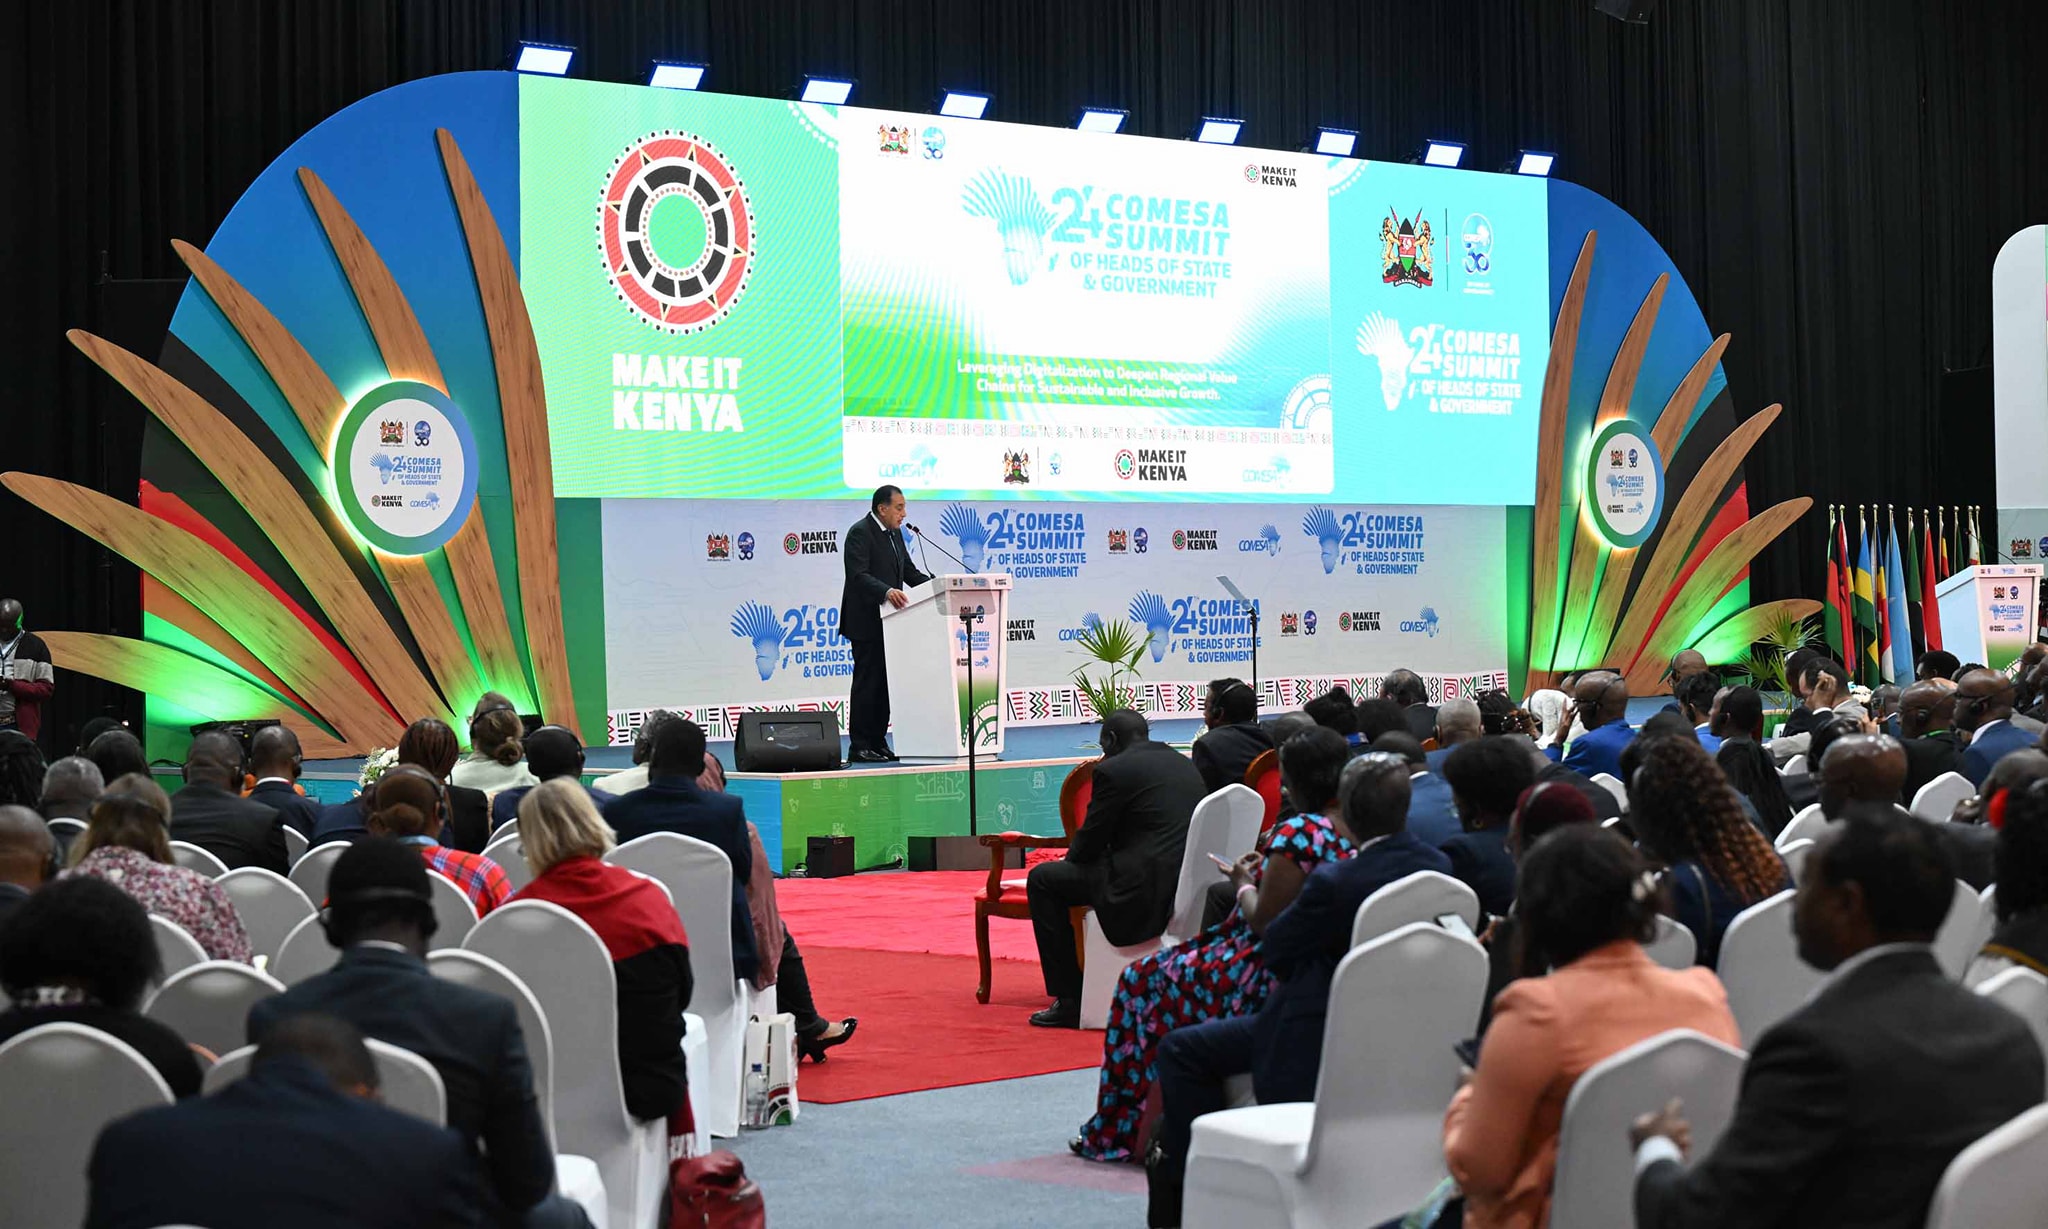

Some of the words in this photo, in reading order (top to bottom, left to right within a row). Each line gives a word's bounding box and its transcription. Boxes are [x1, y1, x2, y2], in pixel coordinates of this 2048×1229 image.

[1262, 165, 1288, 176] MAKE
[1289, 168, 1296, 176] IT
[1262, 176, 1297, 188] KENYA
[1051, 185, 1103, 243] 24
[1106, 193, 1229, 228] COMESA
[1106, 222, 1230, 256] SUMMIT
[1070, 252, 1092, 269] OF
[1097, 253, 1154, 274] HEADS
[1158, 258, 1179, 275] OF
[1183, 260, 1232, 278] STATE
[1083, 274, 1096, 290] &
[1101, 275, 1217, 299] GOVERNMENT
[1409, 324, 1442, 374] 24
[1442, 329, 1520, 356] COMESA
[613, 353, 709, 389] MAKE
[713, 356, 742, 390] IT
[957, 359, 1022, 378] Leveraging
[1024, 363, 1100, 380] Digitalization
[1102, 367, 1114, 379] to
[1117, 366, 1158, 382] Deepen
[1160, 368, 1206, 384] Regional
[1207, 370, 1238, 384] Value
[1442, 354, 1520, 380] SUMMIT
[977, 378, 1016, 392] Chains
[1018, 380, 1034, 393] for
[1037, 381, 1104, 396] Sustainable
[1106, 384, 1127, 396] and
[1129, 384, 1178, 398] Inclusive
[1180, 386, 1221, 400] Growth.
[1422, 380, 1436, 395] OF
[1438, 380, 1474, 396] HEADS
[1475, 382, 1489, 398] OF
[1490, 382, 1521, 398] STATE
[612, 390, 744, 432] KENYA
[1440, 398, 1512, 415] GOVERNMENT
[407, 458, 441, 466] COMESA
[1138, 449, 1174, 463] MAKE
[1176, 450, 1186, 464] IT
[406, 466, 441, 474] SUMMIT
[1138, 464, 1188, 481] KENYA
[987, 509, 1016, 548] 24
[1016, 512, 1084, 530] COMESA
[1187, 530, 1209, 539] MAKE
[1210, 530, 1217, 538] IT
[1342, 512, 1366, 547] 24
[1366, 515, 1422, 532] COMESA
[802, 532, 827, 542] MAKE
[828, 531, 838, 541] IT
[1016, 532, 1085, 550] SUMMIT
[1366, 532, 1424, 548] SUMMIT
[802, 542, 838, 554] KENYA
[1188, 540, 1218, 550] KENYA
[1238, 540, 1269, 552] COMESA
[998, 554, 1010, 564] OF
[1012, 553, 1044, 564] HEADS
[1046, 552, 1057, 564] OF
[1059, 552, 1086, 564] STATE
[1351, 552, 1362, 562] OF
[1363, 552, 1388, 562] HEADS
[1390, 552, 1400, 562] OF
[1402, 552, 1424, 562] STATE
[1015, 566, 1078, 578] GOVERNMENT
[1356, 564, 1363, 574] &
[1364, 564, 1418, 574] GOVERNMENT
[1172, 596, 1198, 634] 24
[1352, 612, 1374, 620] MAKE
[1374, 612, 1380, 620] IT
[783, 605, 814, 647] 24
[1027, 620, 1035, 628] IT
[1198, 618, 1260, 636] SUMMI
[1352, 622, 1380, 632] KENYA
[1400, 622, 1428, 632] COMESA
[1007, 630, 1036, 641] ENYA
[1182, 638, 1193, 650] OF
[1195, 638, 1222, 650] HEADS
[1224, 638, 1236, 649] OF
[1236, 636, 1262, 648] STAE
[796, 652, 808, 664] OF
[811, 650, 845, 662] HEADS
[847, 650, 854, 661] O
[1188, 652, 1195, 663] &
[1196, 650, 1254, 663] GOVERNMENT
[804, 666, 812, 678] &
[814, 664, 854, 676] GOVERN
